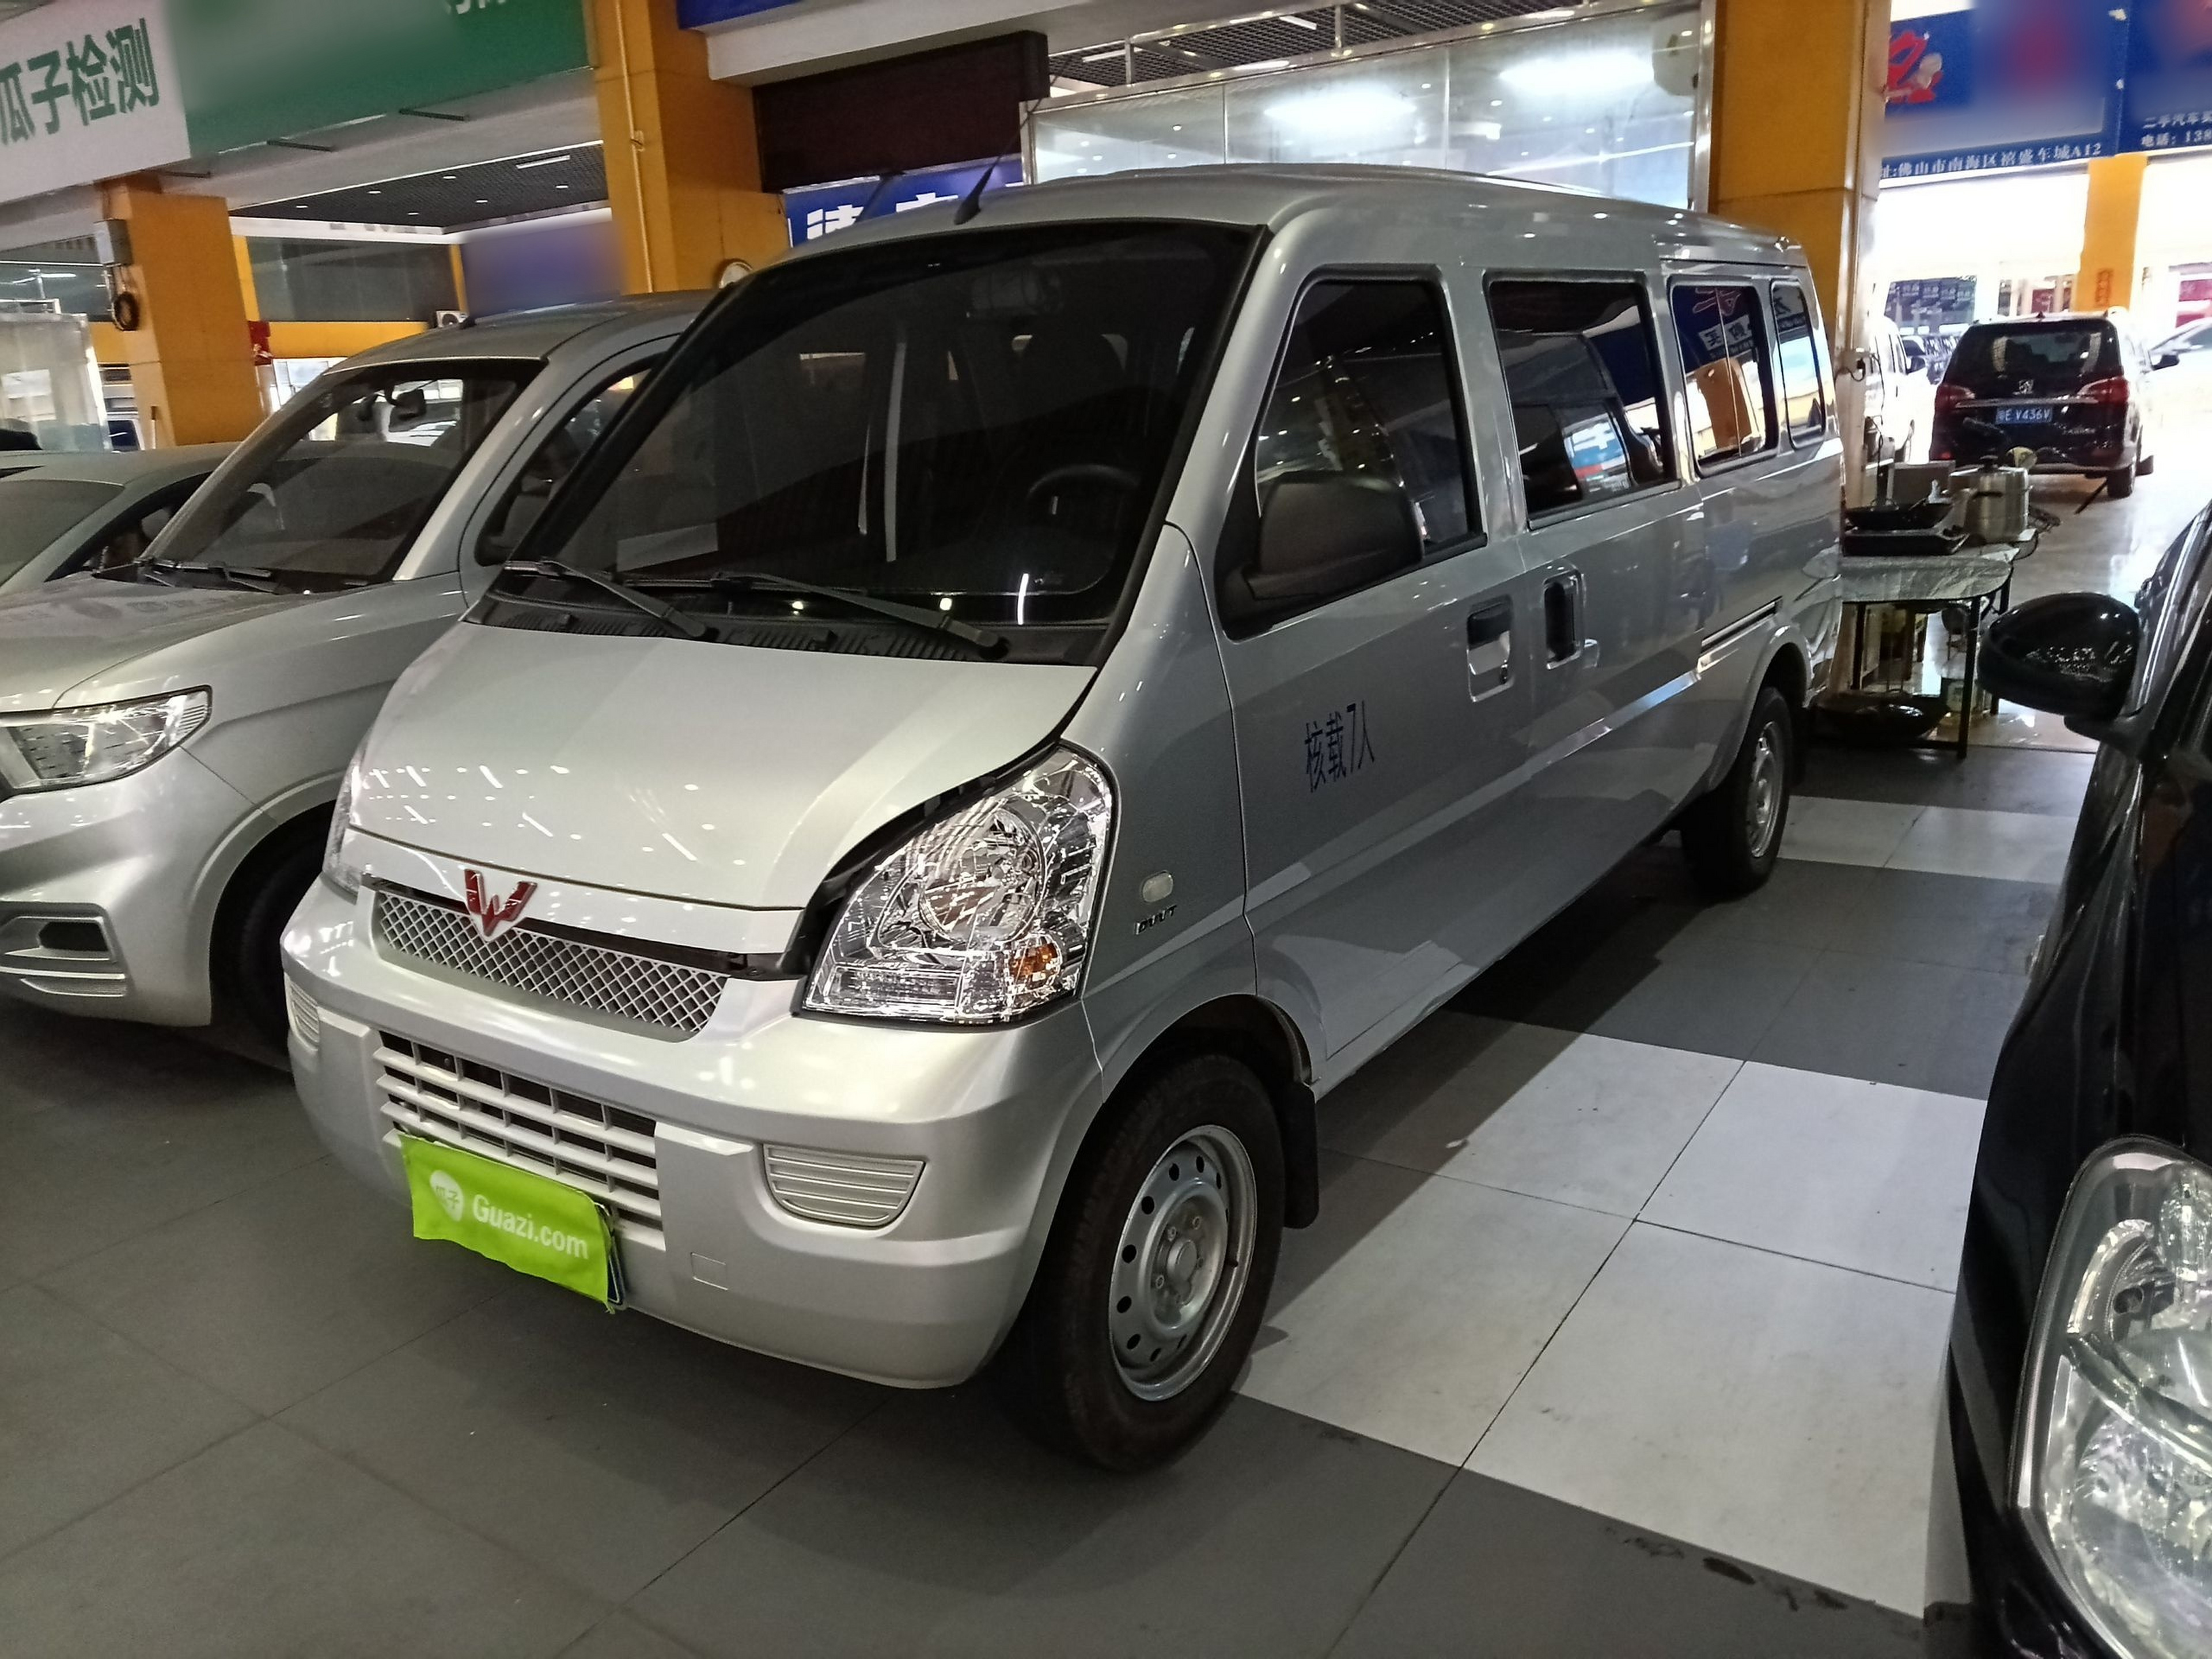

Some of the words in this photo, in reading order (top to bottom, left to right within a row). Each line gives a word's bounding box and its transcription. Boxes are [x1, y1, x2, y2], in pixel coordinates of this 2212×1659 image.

[0, 18, 159, 145] 瓜子检测
[1305, 700, 1374, 793] 核载7人
[473, 1194, 589, 1260] Guazi.com
